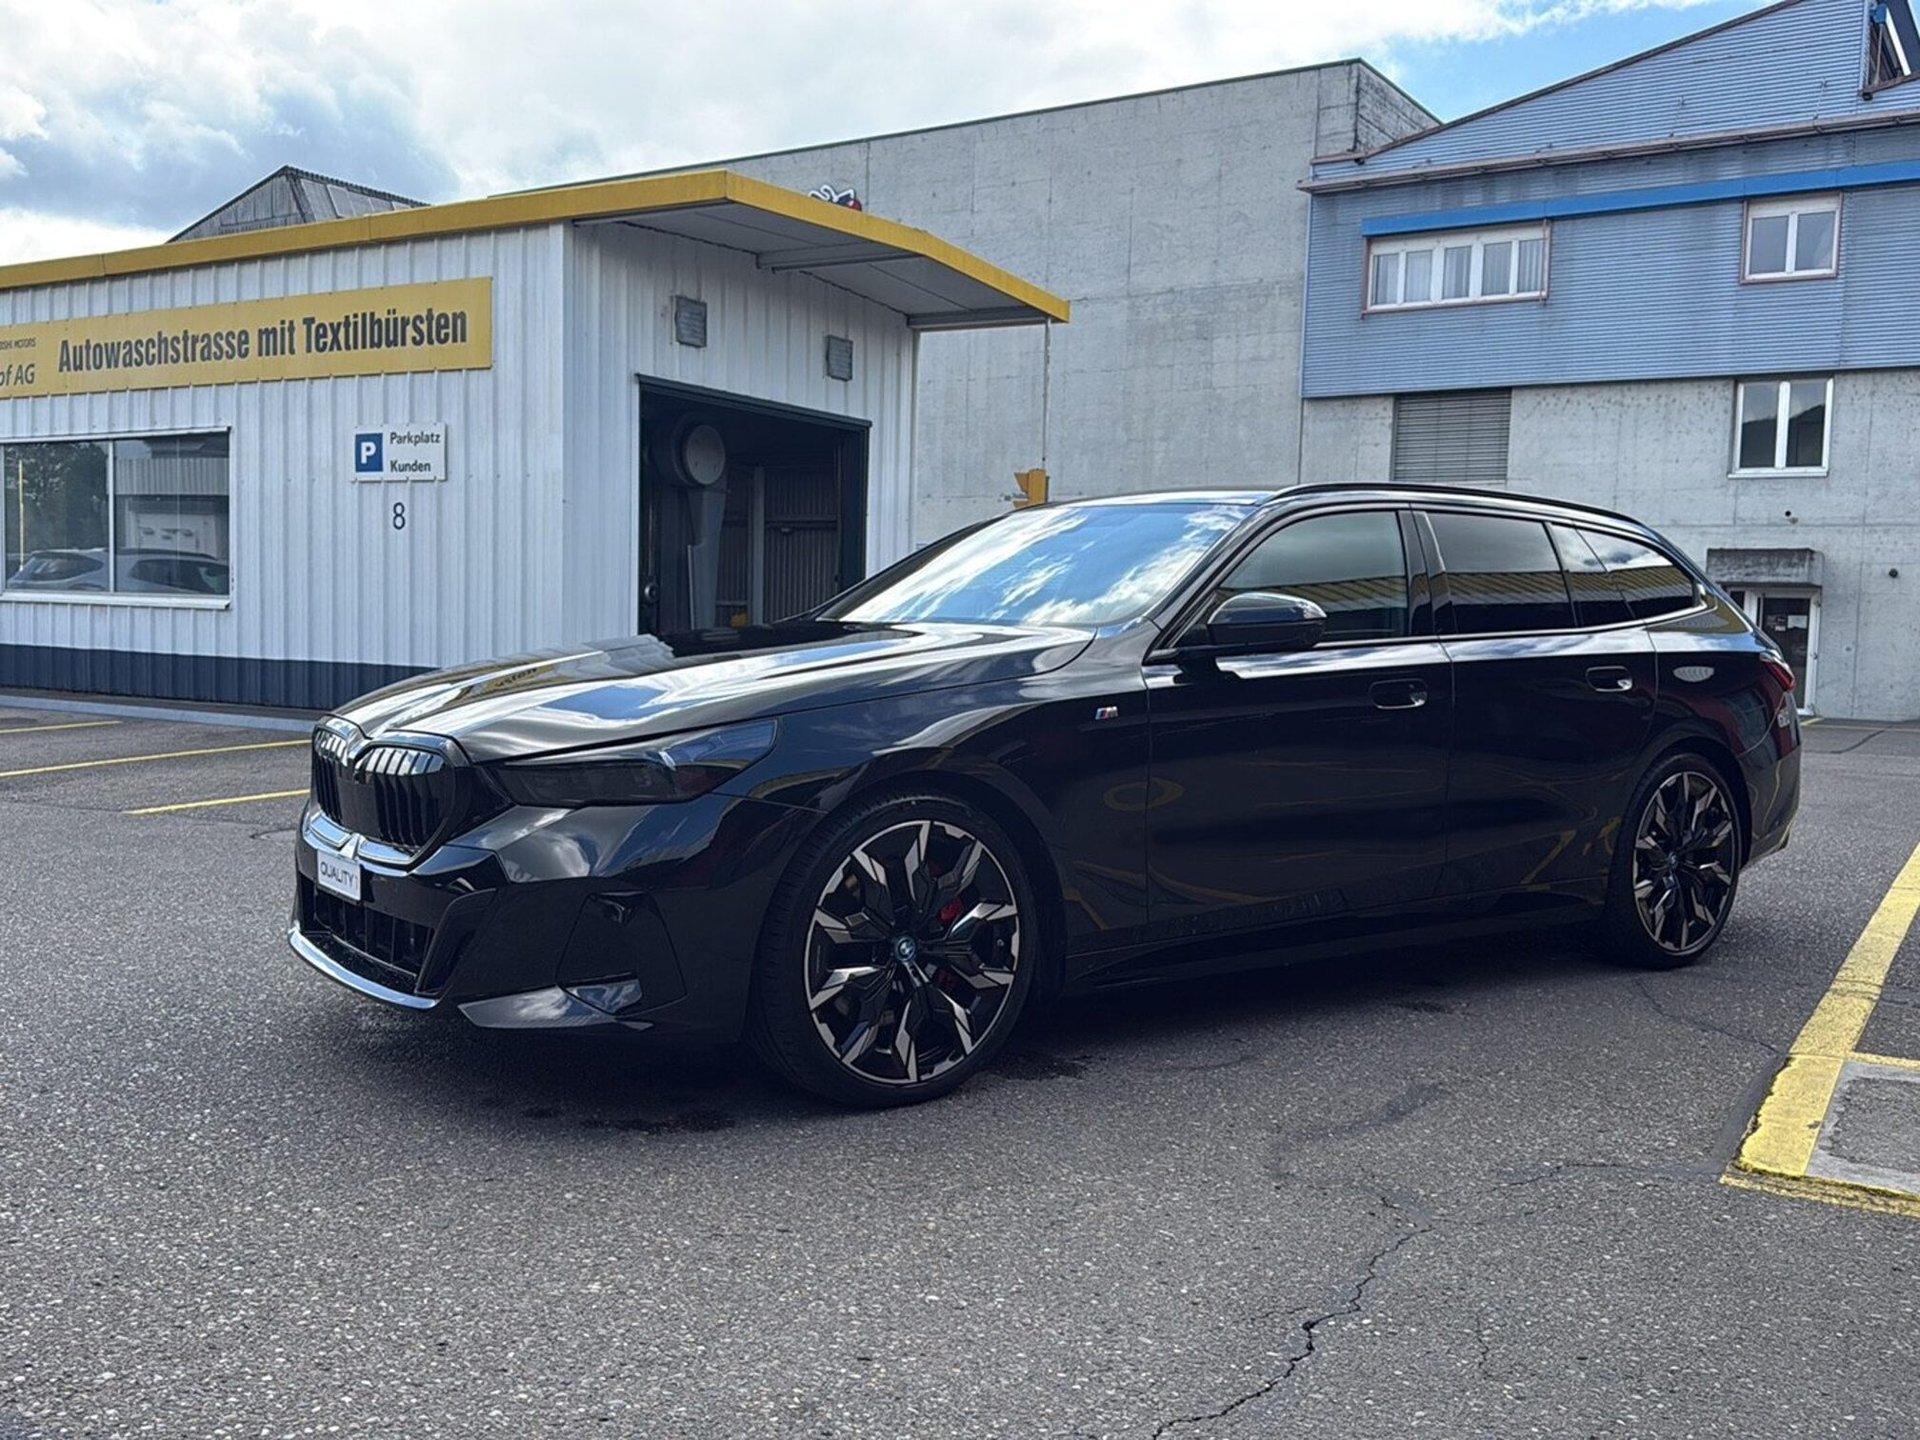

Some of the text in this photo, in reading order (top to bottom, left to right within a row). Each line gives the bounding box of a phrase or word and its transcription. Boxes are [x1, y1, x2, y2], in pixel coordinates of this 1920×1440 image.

[58, 308, 468, 373] Autowaschstrasse mit Textilbürsten
[14, 363, 35, 386] AG
[389, 431, 441, 447] Parkplatz
[361, 441, 377, 464] P
[389, 459, 431, 473] Kunden
[393, 501, 406, 530] 8
